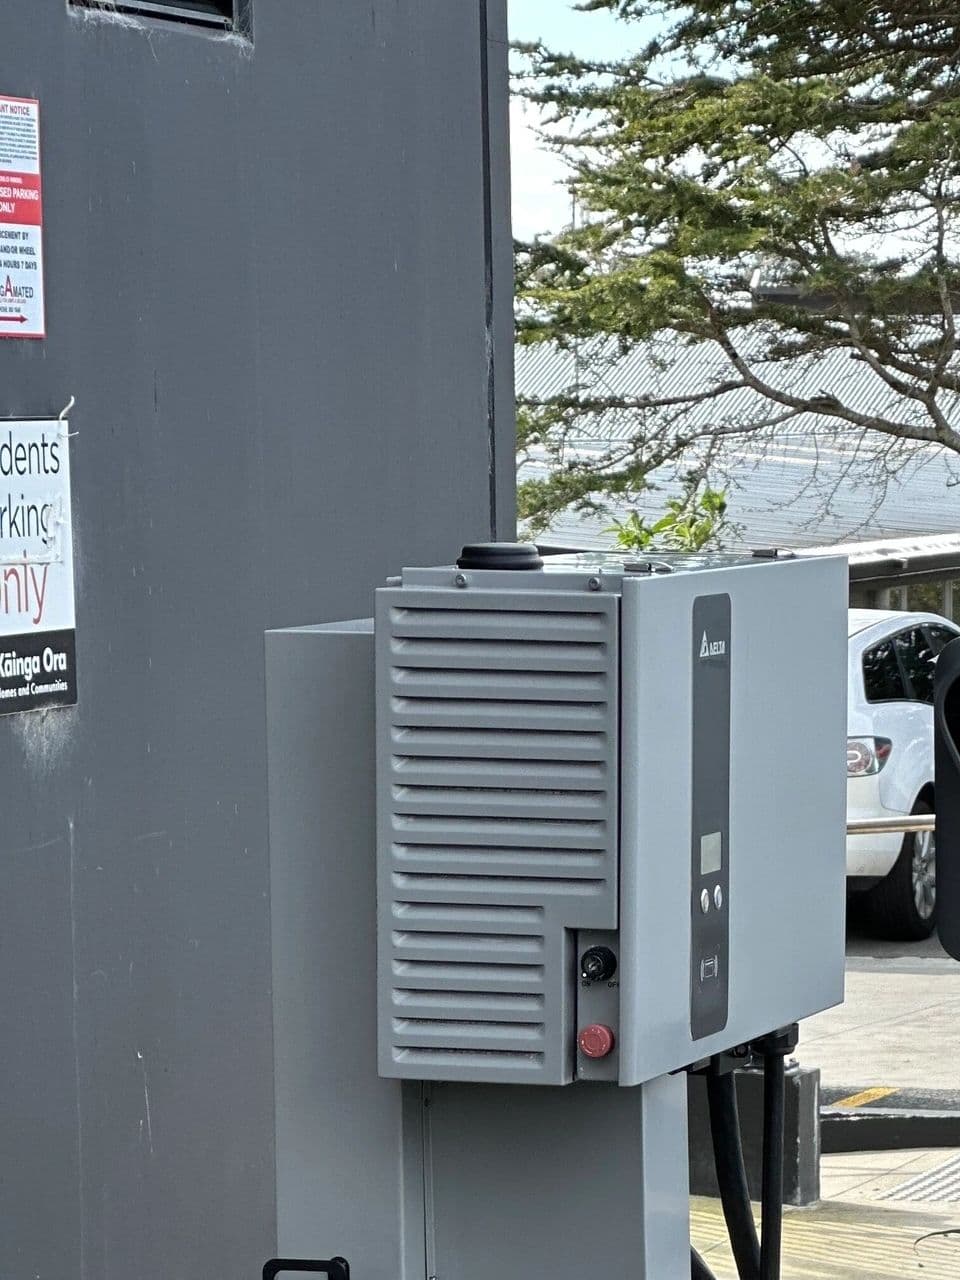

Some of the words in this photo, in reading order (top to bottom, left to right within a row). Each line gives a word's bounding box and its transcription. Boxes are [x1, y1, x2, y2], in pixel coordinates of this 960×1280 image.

[10, 105, 30, 116] NOTICE
[13, 187, 39, 200] PARKING
[22, 231, 29, 240] BY
[19, 246, 36, 255] WHEEL
[3, 260, 20, 269] HOURS
[25, 261, 37, 270] DAYS
[0, 430, 60, 476] dents
[0, 549, 48, 625] nly
[43, 647, 67, 673] Ora
[0, 687, 17, 699] omes
[18, 683, 30, 697] and
[31, 679, 68, 695] Communities
